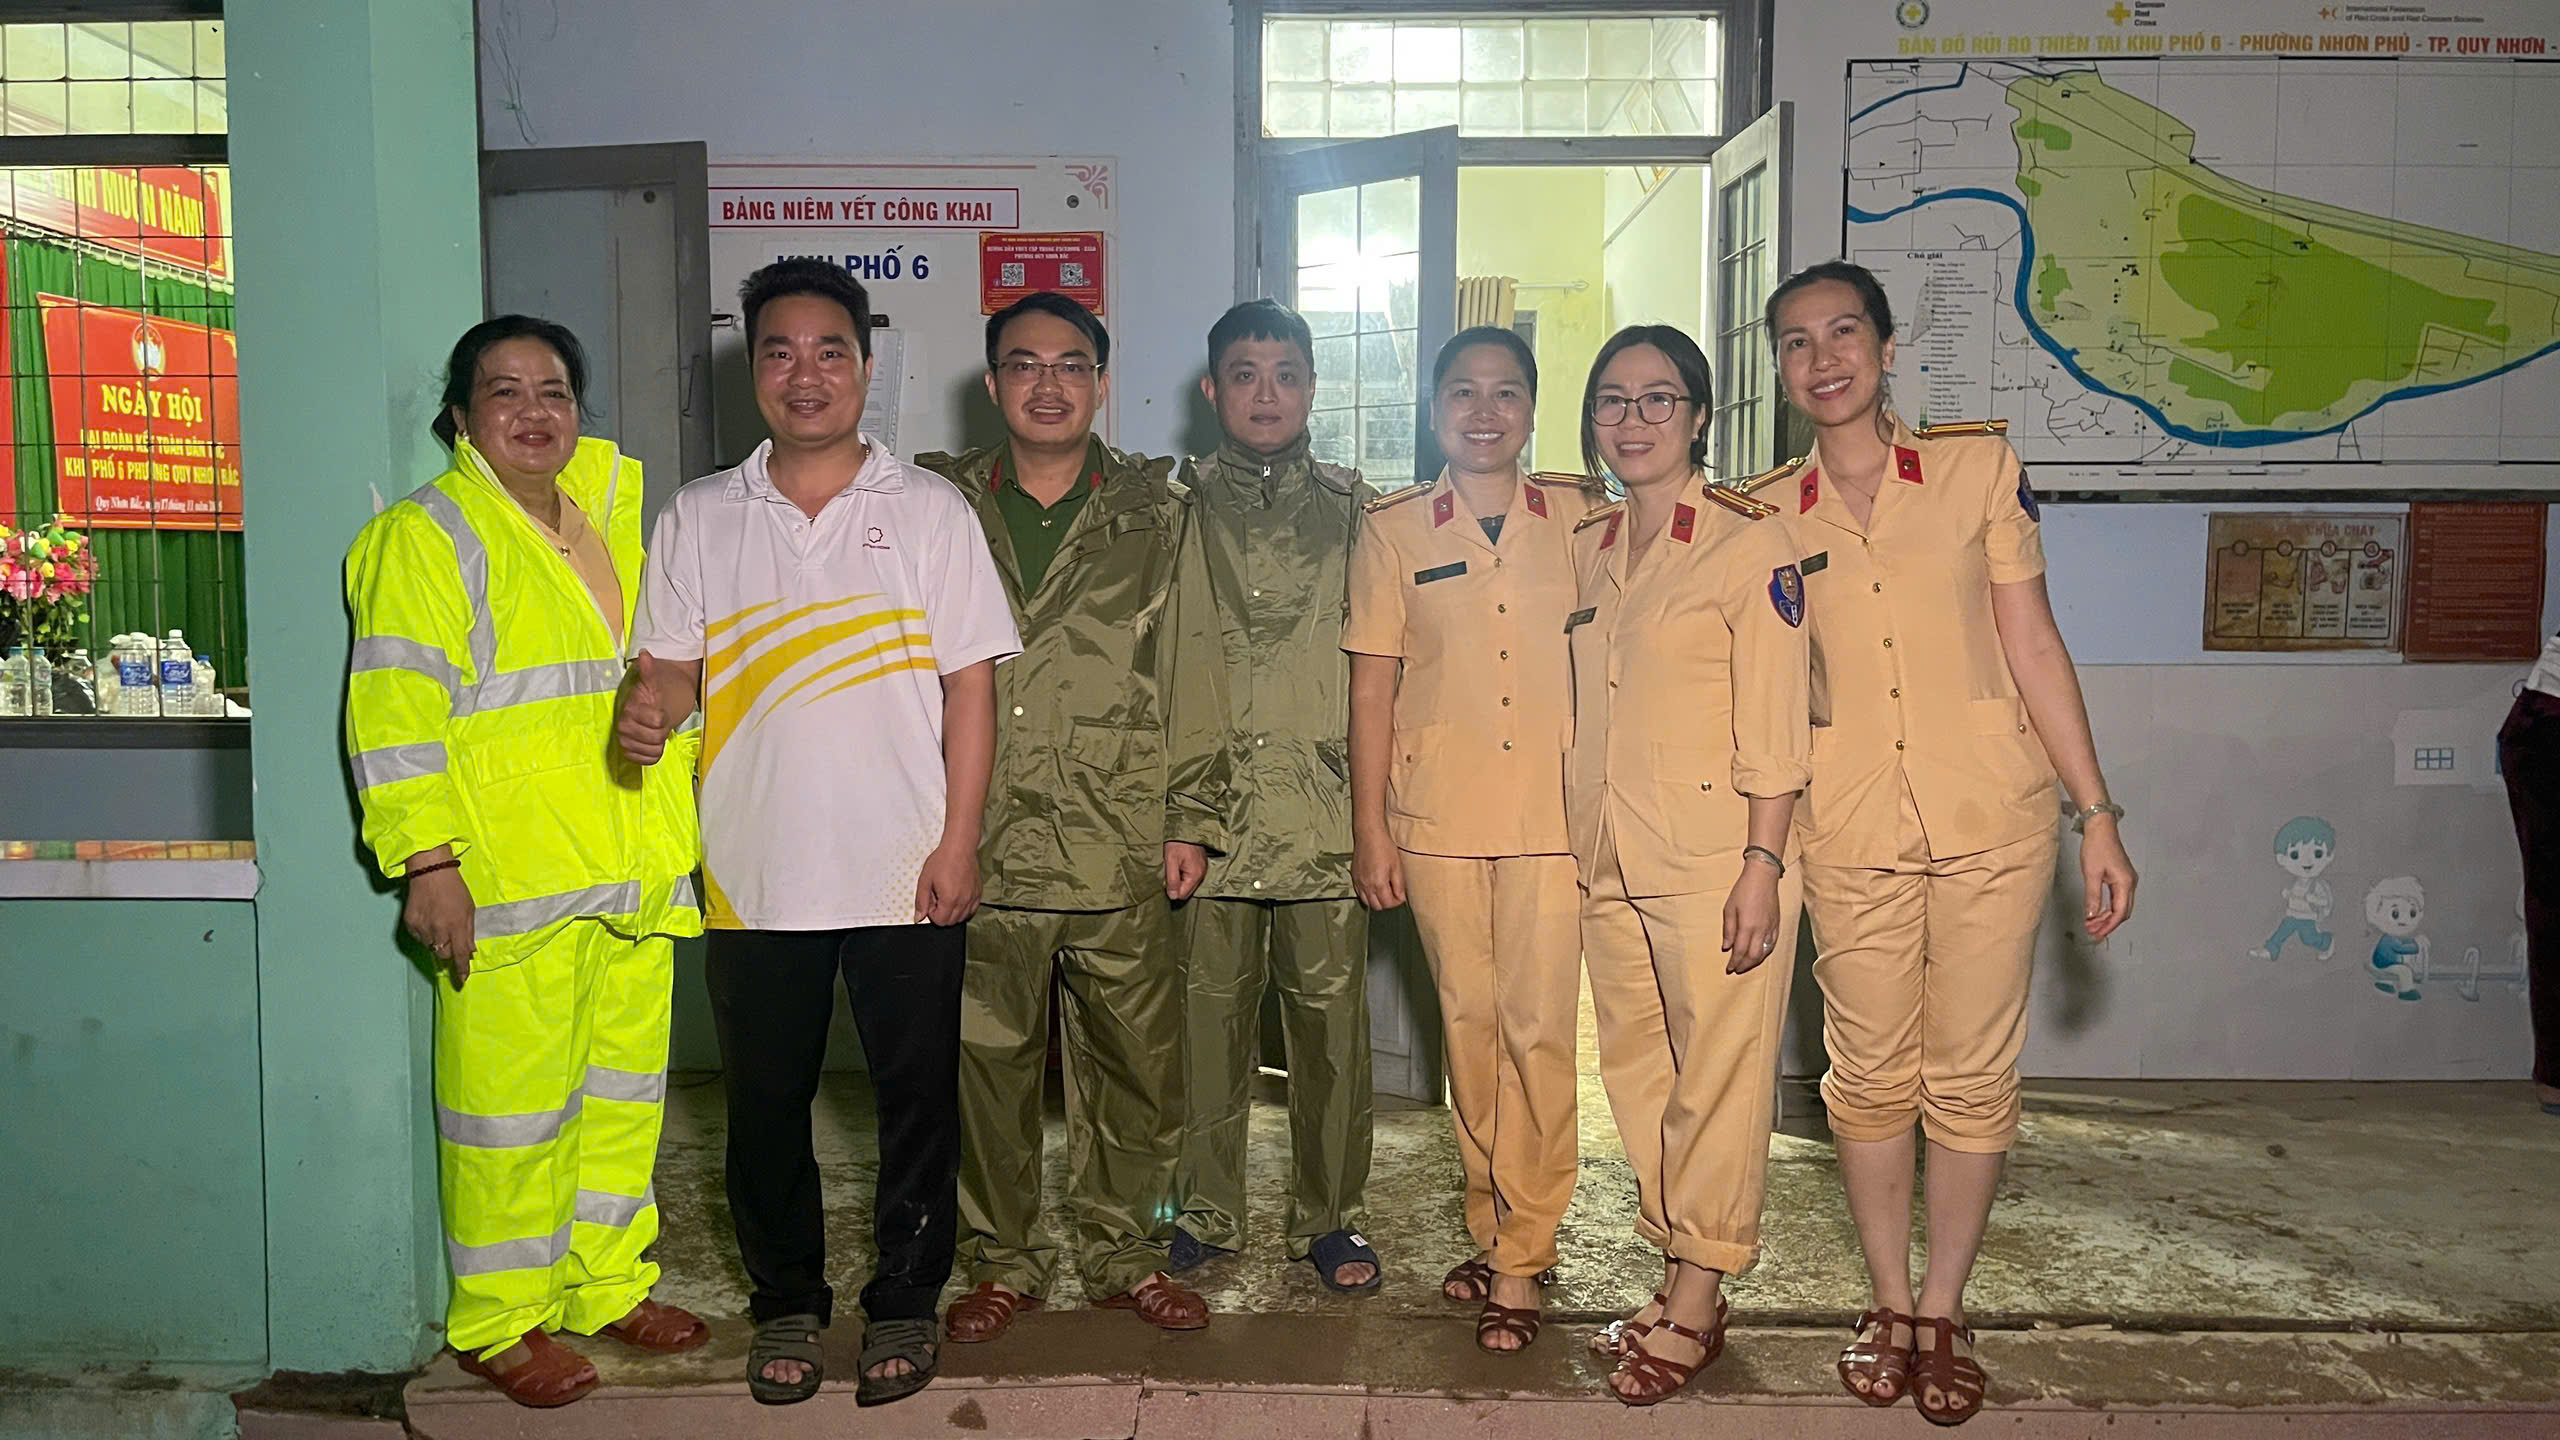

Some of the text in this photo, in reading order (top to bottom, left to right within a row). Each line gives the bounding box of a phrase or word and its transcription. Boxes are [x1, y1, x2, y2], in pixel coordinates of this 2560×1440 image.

[2127, 35, 2161, 51] KHU
[2168, 31, 2205, 51] PHỐ
[2211, 35, 2221, 51] 6
[2240, 31, 2312, 52] PHƯỜNG
[2319, 34, 2369, 52] NHƠN
[2428, 36, 2451, 53] TP.
[2457, 36, 2491, 54] QUY
[2496, 36, 2546, 54] NHƠN
[722, 194, 993, 222] BẢNG NIÊM YẾT CÔNG KHAI
[846, 244, 930, 280] PHỐ 6
[101, 380, 203, 428] NGÀY HỘI
[91, 453, 116, 479] PHỐ
[117, 460, 125, 481] 6
[172, 464, 191, 485] QUY
